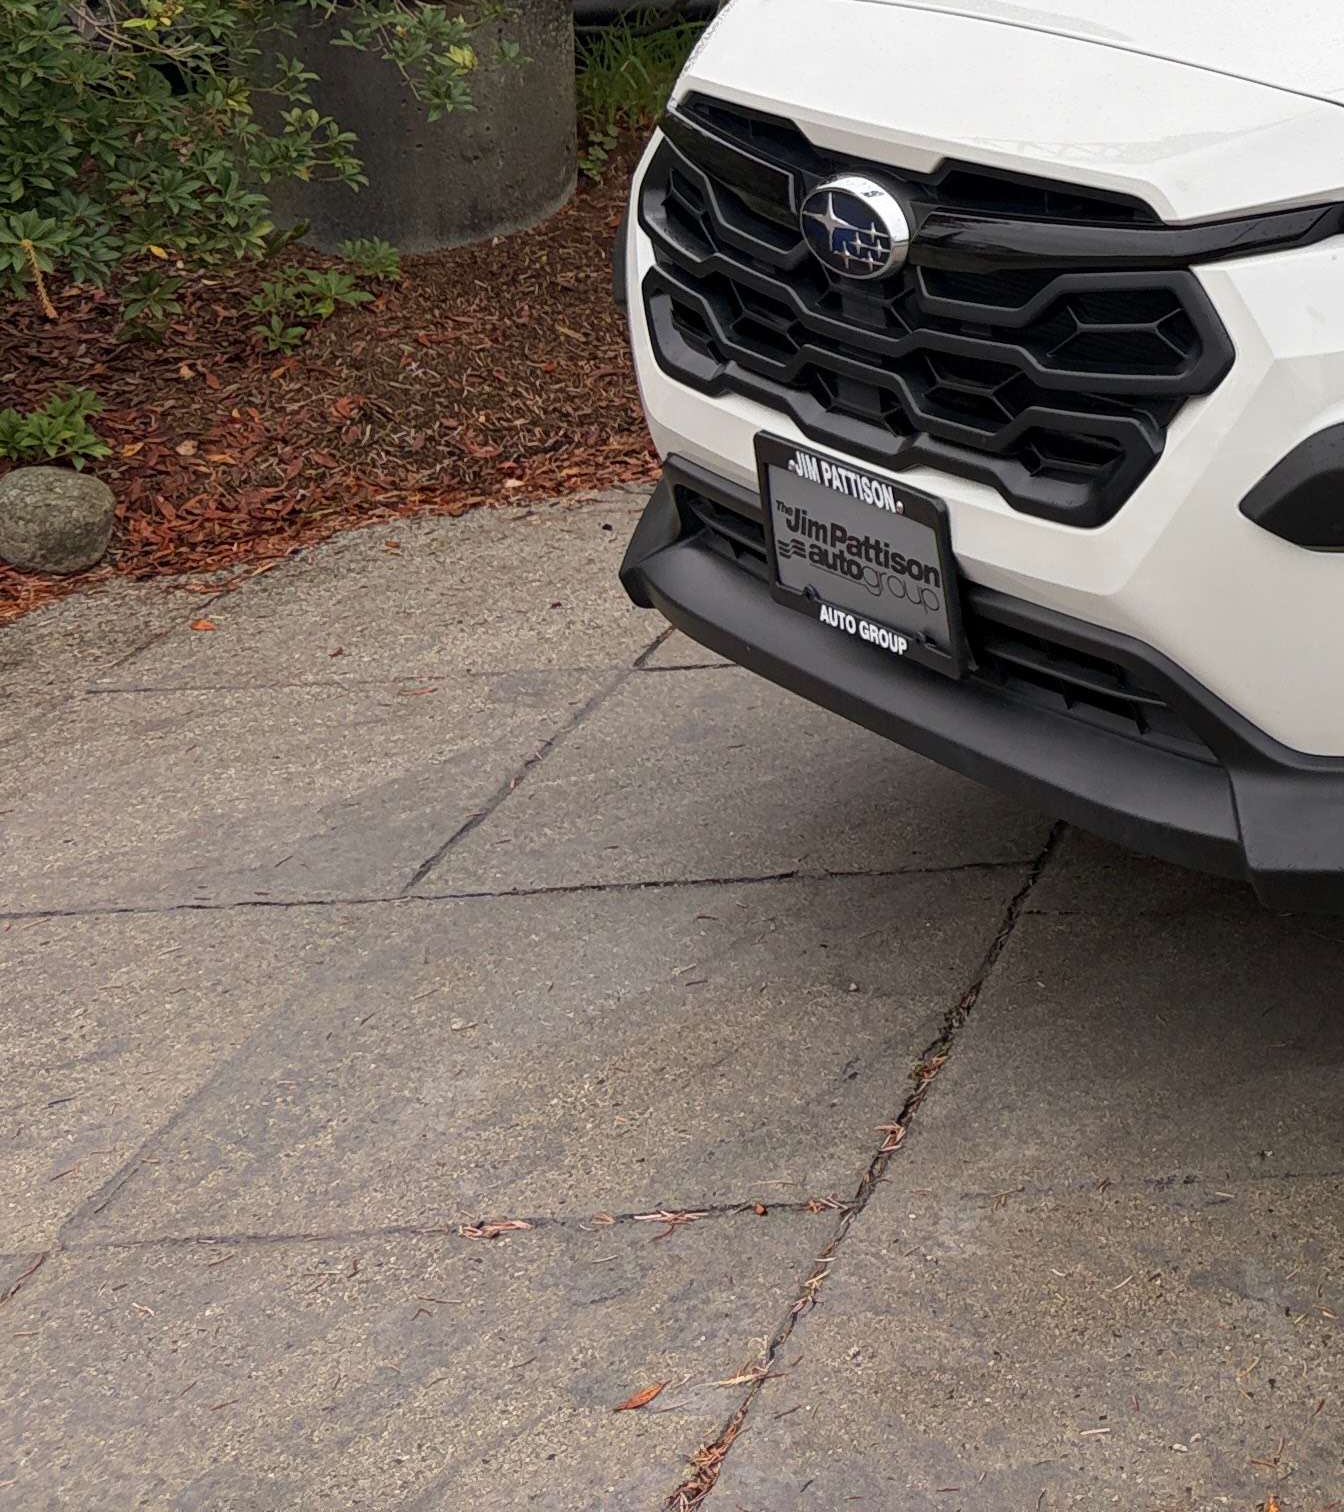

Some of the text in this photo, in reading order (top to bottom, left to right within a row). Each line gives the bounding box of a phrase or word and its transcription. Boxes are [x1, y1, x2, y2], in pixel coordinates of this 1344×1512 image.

[795, 450, 897, 514] JIM PATTISON
[776, 500, 793, 516] The
[820, 604, 908, 655] AUTO GROUP
